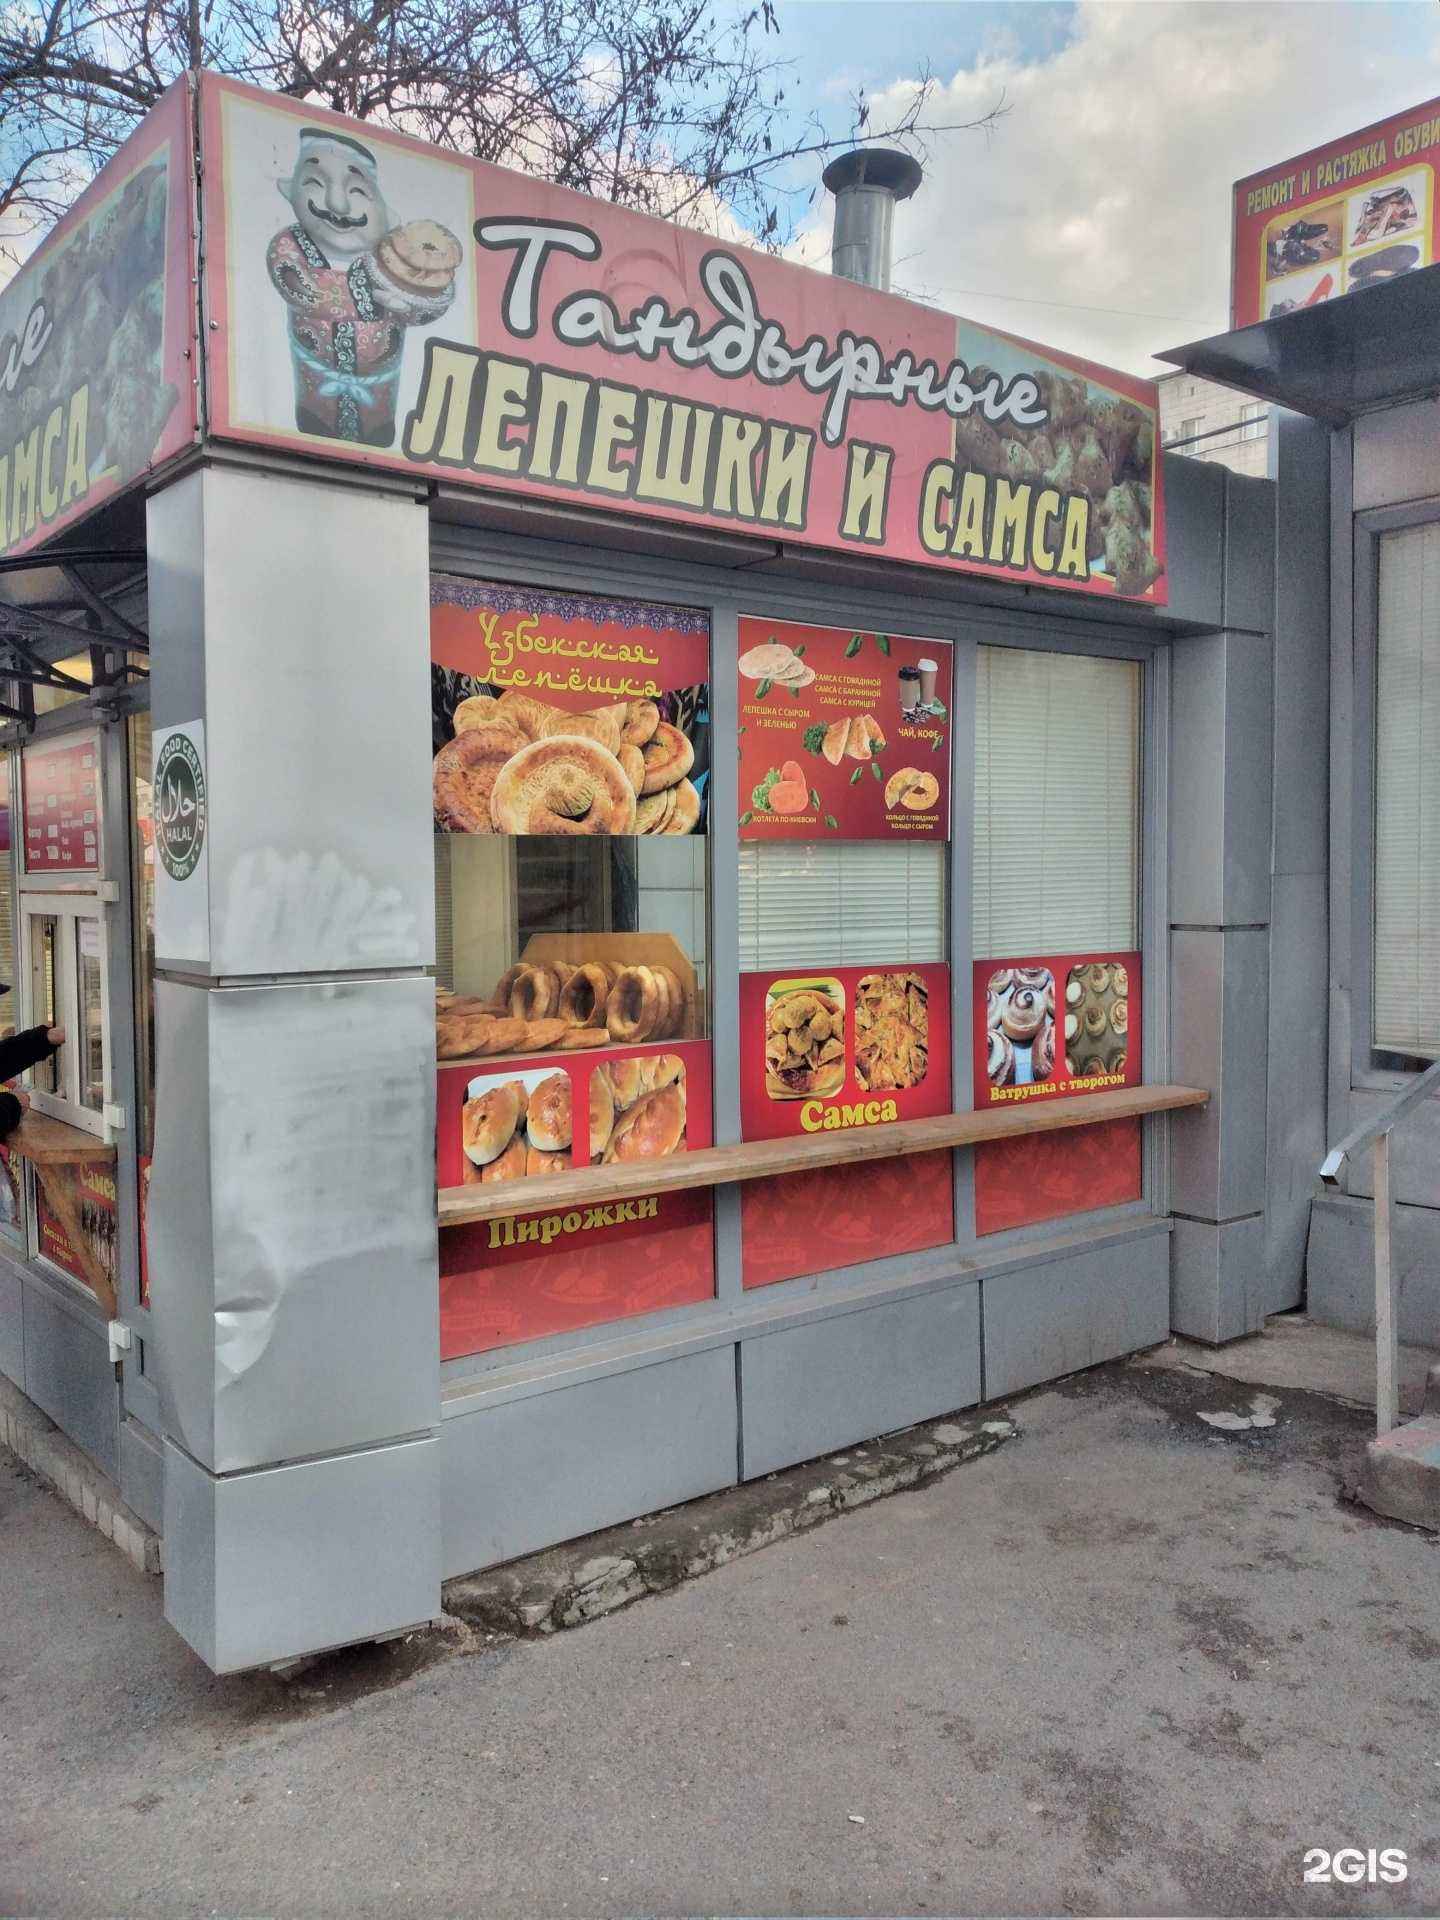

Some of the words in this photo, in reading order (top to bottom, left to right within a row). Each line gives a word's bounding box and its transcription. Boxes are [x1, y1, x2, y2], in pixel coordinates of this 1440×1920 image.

[1247, 175, 1296, 216] РЕМОНТ
[1301, 168, 1311, 195] И
[1316, 139, 1387, 189] РАСТЯЖКА
[1394, 117, 1440, 159] ОБУВИ
[474, 218, 1049, 444] Тандырные
[405, 341, 814, 531] ЛЕПЕШКИ
[841, 440, 894, 544] И
[920, 461, 1092, 580] САМСА
[479, 612, 659, 666] Узбекская
[476, 667, 662, 699] лепёшка
[815, 673, 838, 683] САМСА
[815, 685, 838, 695] САМСА
[743, 705, 777, 716] ЛЕПЕШКА
[778, 708, 783, 716] С
[784, 708, 810, 718] СЫРОМ
[820, 696, 842, 706] САМСА
[848, 699, 876, 709] КУРИЦЕЙ
[762, 719, 797, 729] ЗЕЛЕНЬЮ
[898, 726, 916, 739] ЧАЙ,
[918, 729, 940, 738] КОФЕ
[161, 737, 181, 767] FOOD
[183, 738, 206, 832] CERTIFIED
[162, 773, 197, 824] حلال
[166, 826, 193, 843] HALAL
[990, 1082, 1056, 1101] Ватрушка
[1060, 1082, 1066, 1091] с
[1070, 1074, 1125, 1090] творогом
[800, 1099, 897, 1133] Самса
[487, 1196, 659, 1251] Пирожки
